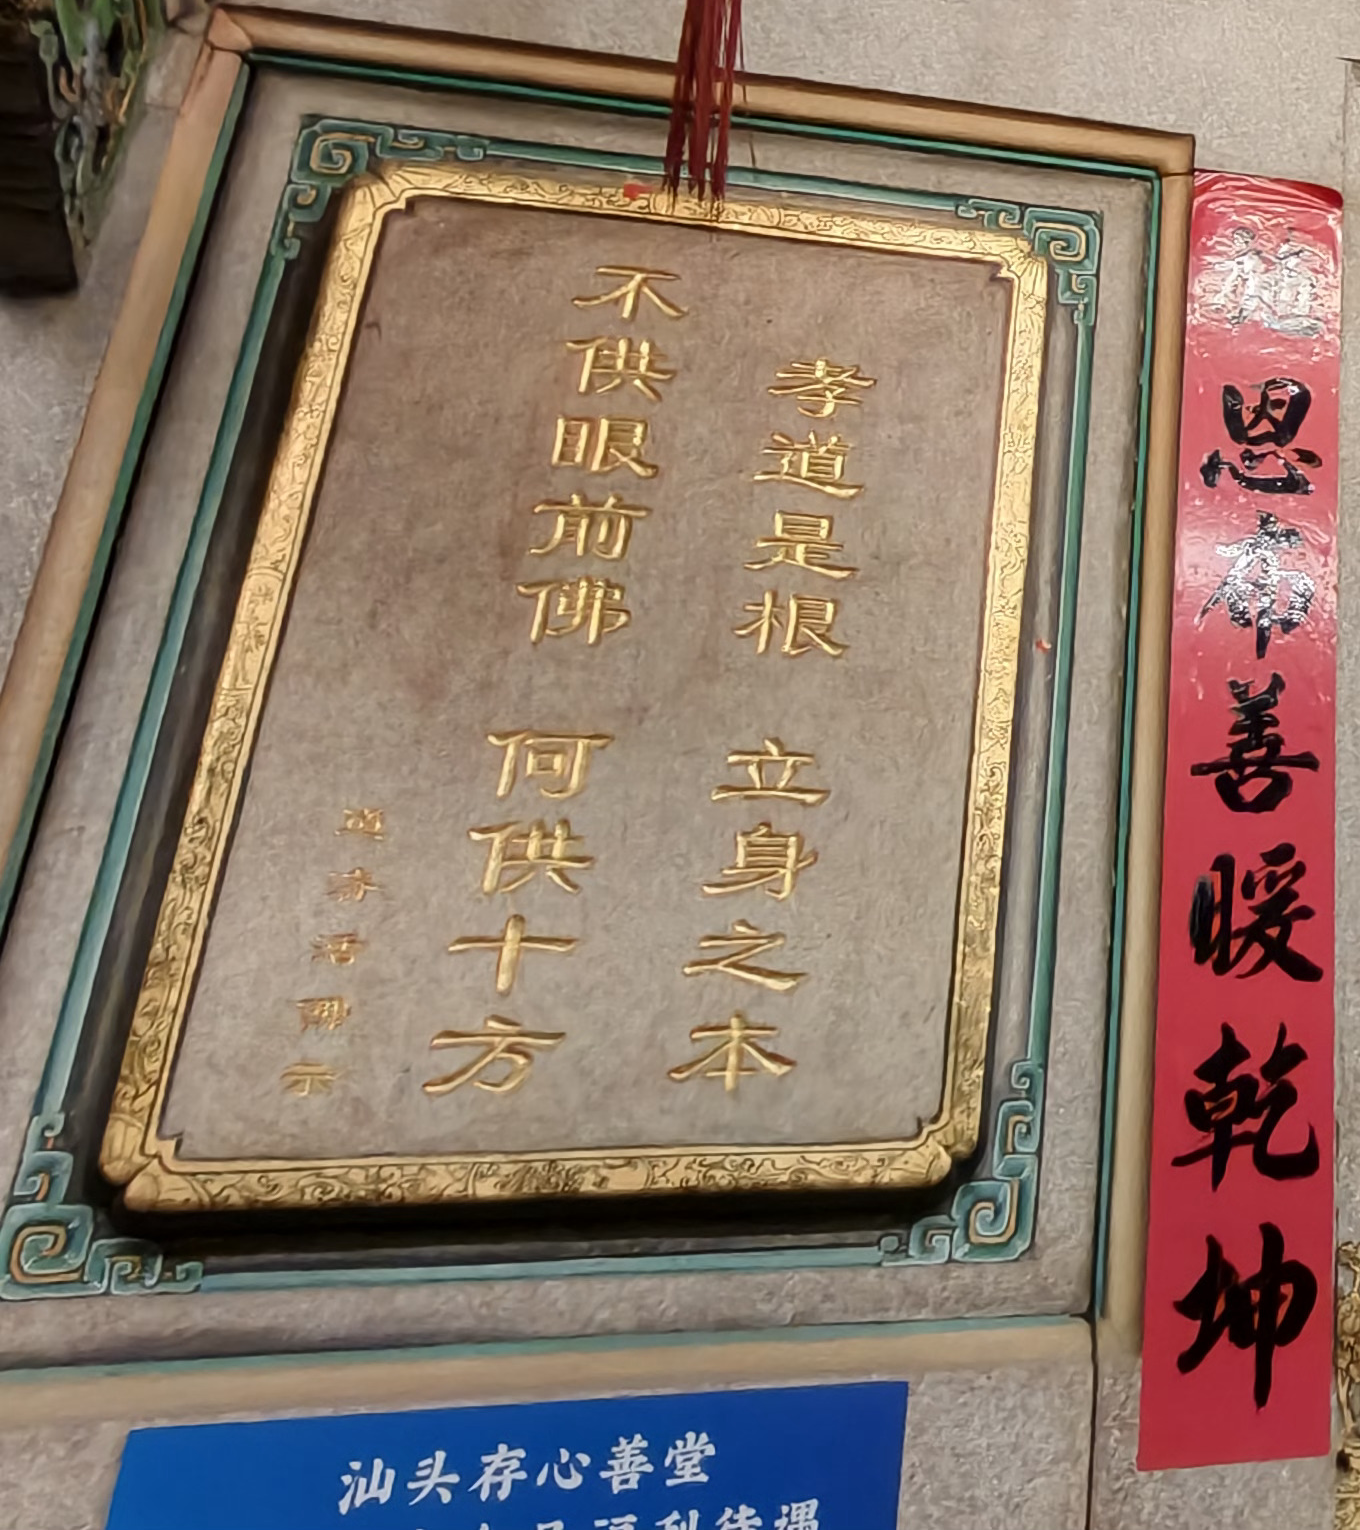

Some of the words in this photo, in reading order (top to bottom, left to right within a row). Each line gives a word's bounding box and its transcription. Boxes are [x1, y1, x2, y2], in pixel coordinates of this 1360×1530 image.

[516, 265, 690, 645] 不供眼前佛
[734, 355, 877, 658] 孝道是根
[421, 728, 616, 1095] 何供十方
[668, 736, 831, 1093] 立身之本
[337, 1430, 718, 1517] 汕头存心善堂
